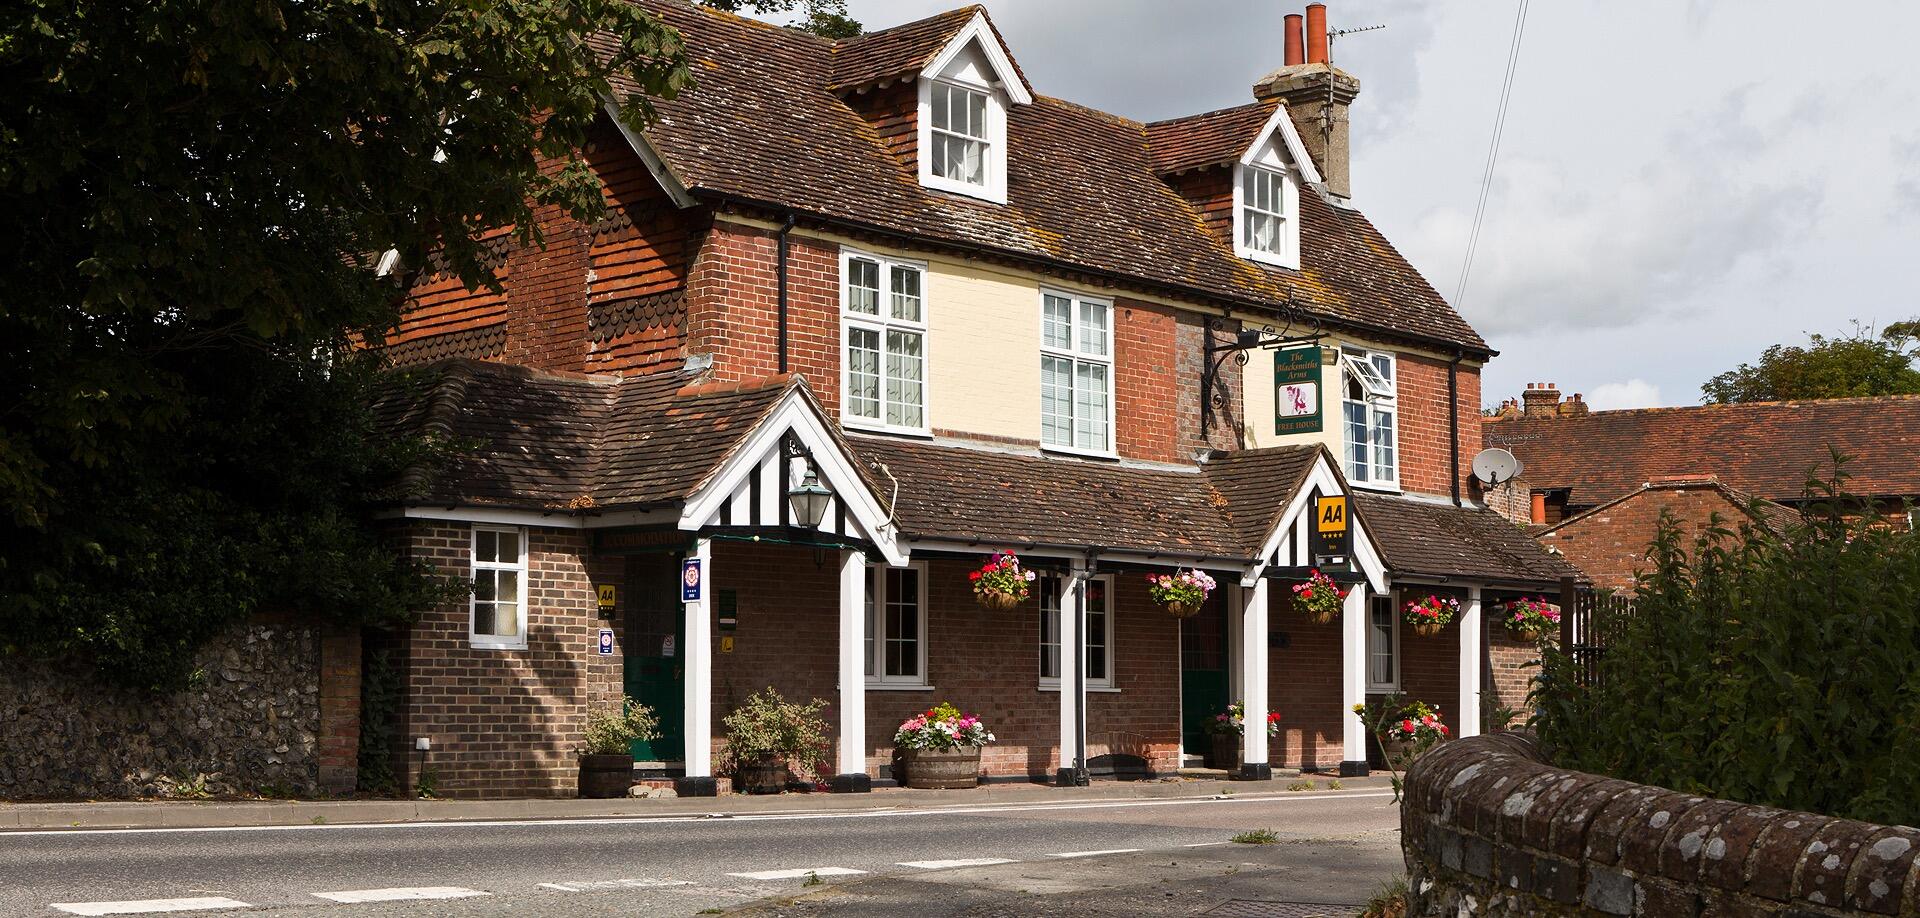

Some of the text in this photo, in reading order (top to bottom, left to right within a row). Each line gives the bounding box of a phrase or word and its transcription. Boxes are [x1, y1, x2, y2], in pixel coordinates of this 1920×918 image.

[1291, 352, 1304, 361] The
[1277, 361, 1318, 372] Blacksmiths
[1288, 371, 1308, 379] Arms
[1277, 420, 1319, 431] FREE HOUSE
[1322, 505, 1342, 523] AA
[601, 590, 613, 601] AA
